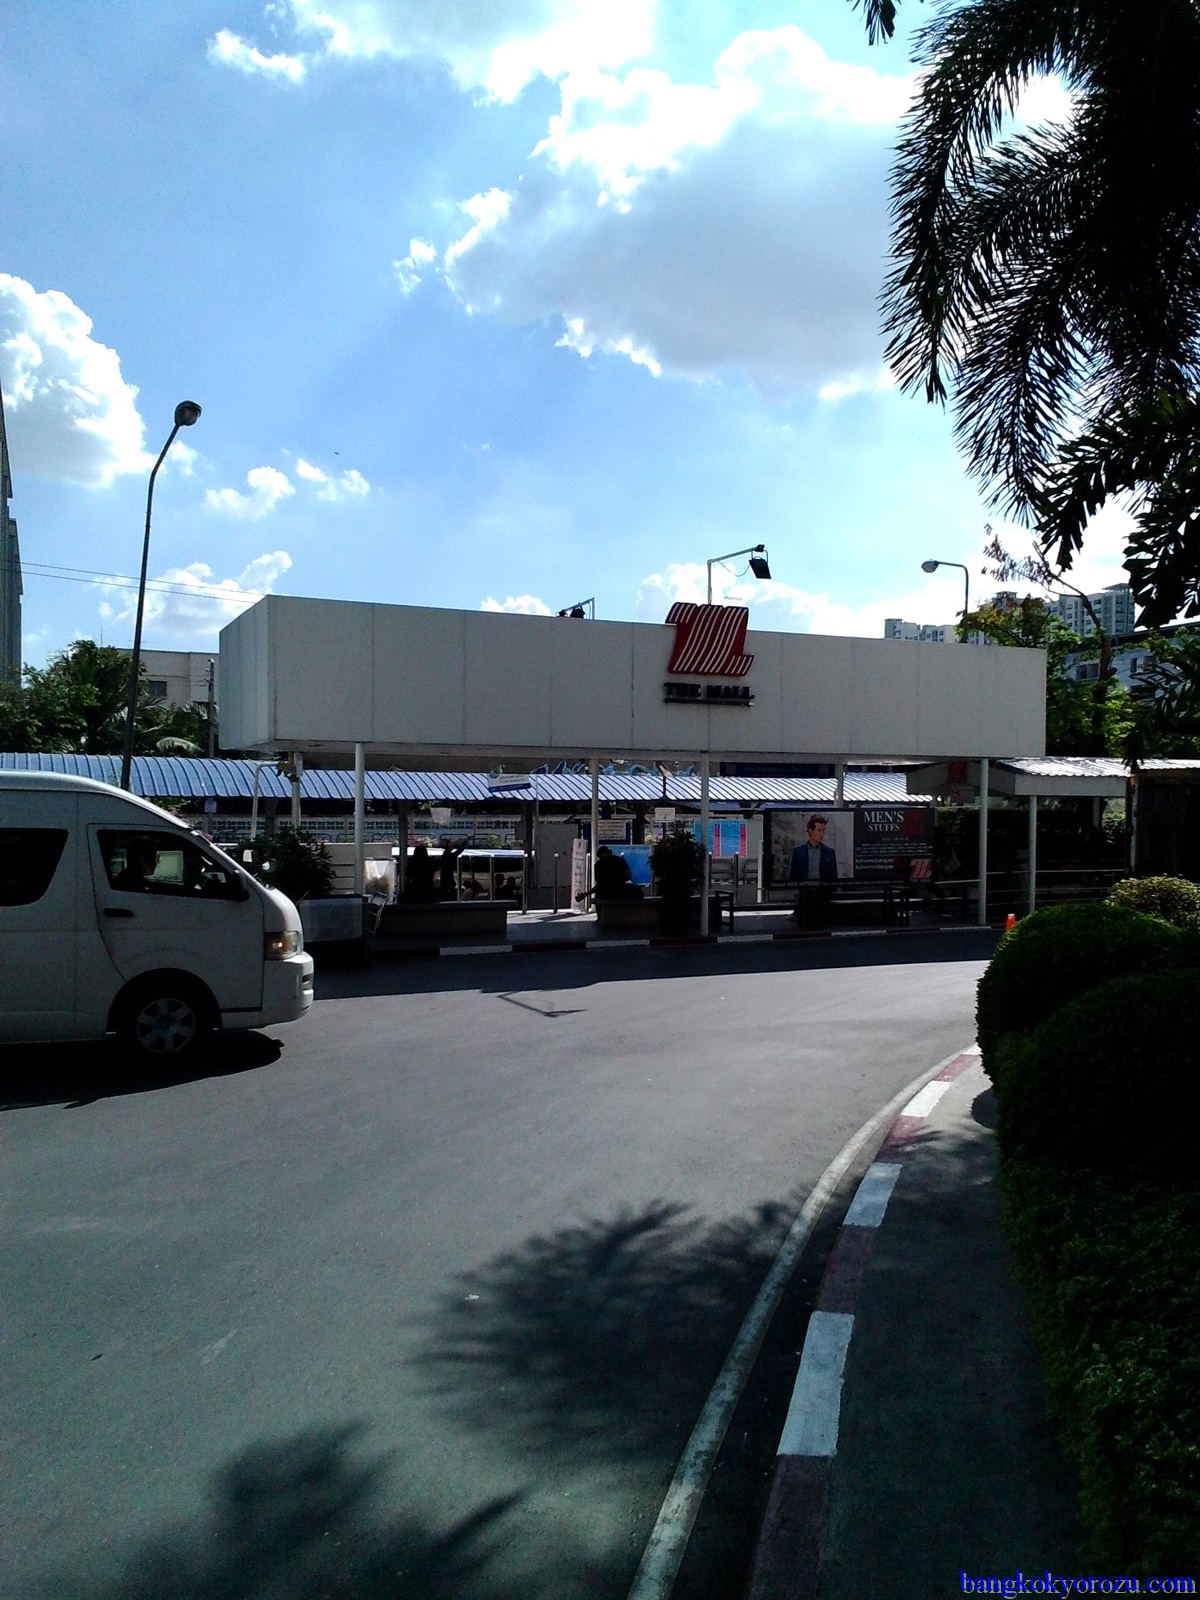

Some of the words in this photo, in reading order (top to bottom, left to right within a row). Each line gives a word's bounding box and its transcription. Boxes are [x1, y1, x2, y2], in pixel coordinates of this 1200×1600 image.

[664, 682, 701, 697] THE
[707, 684, 755, 699] MALL
[864, 811, 904, 823] MEN'S
[868, 823, 900, 832] STUFFS
